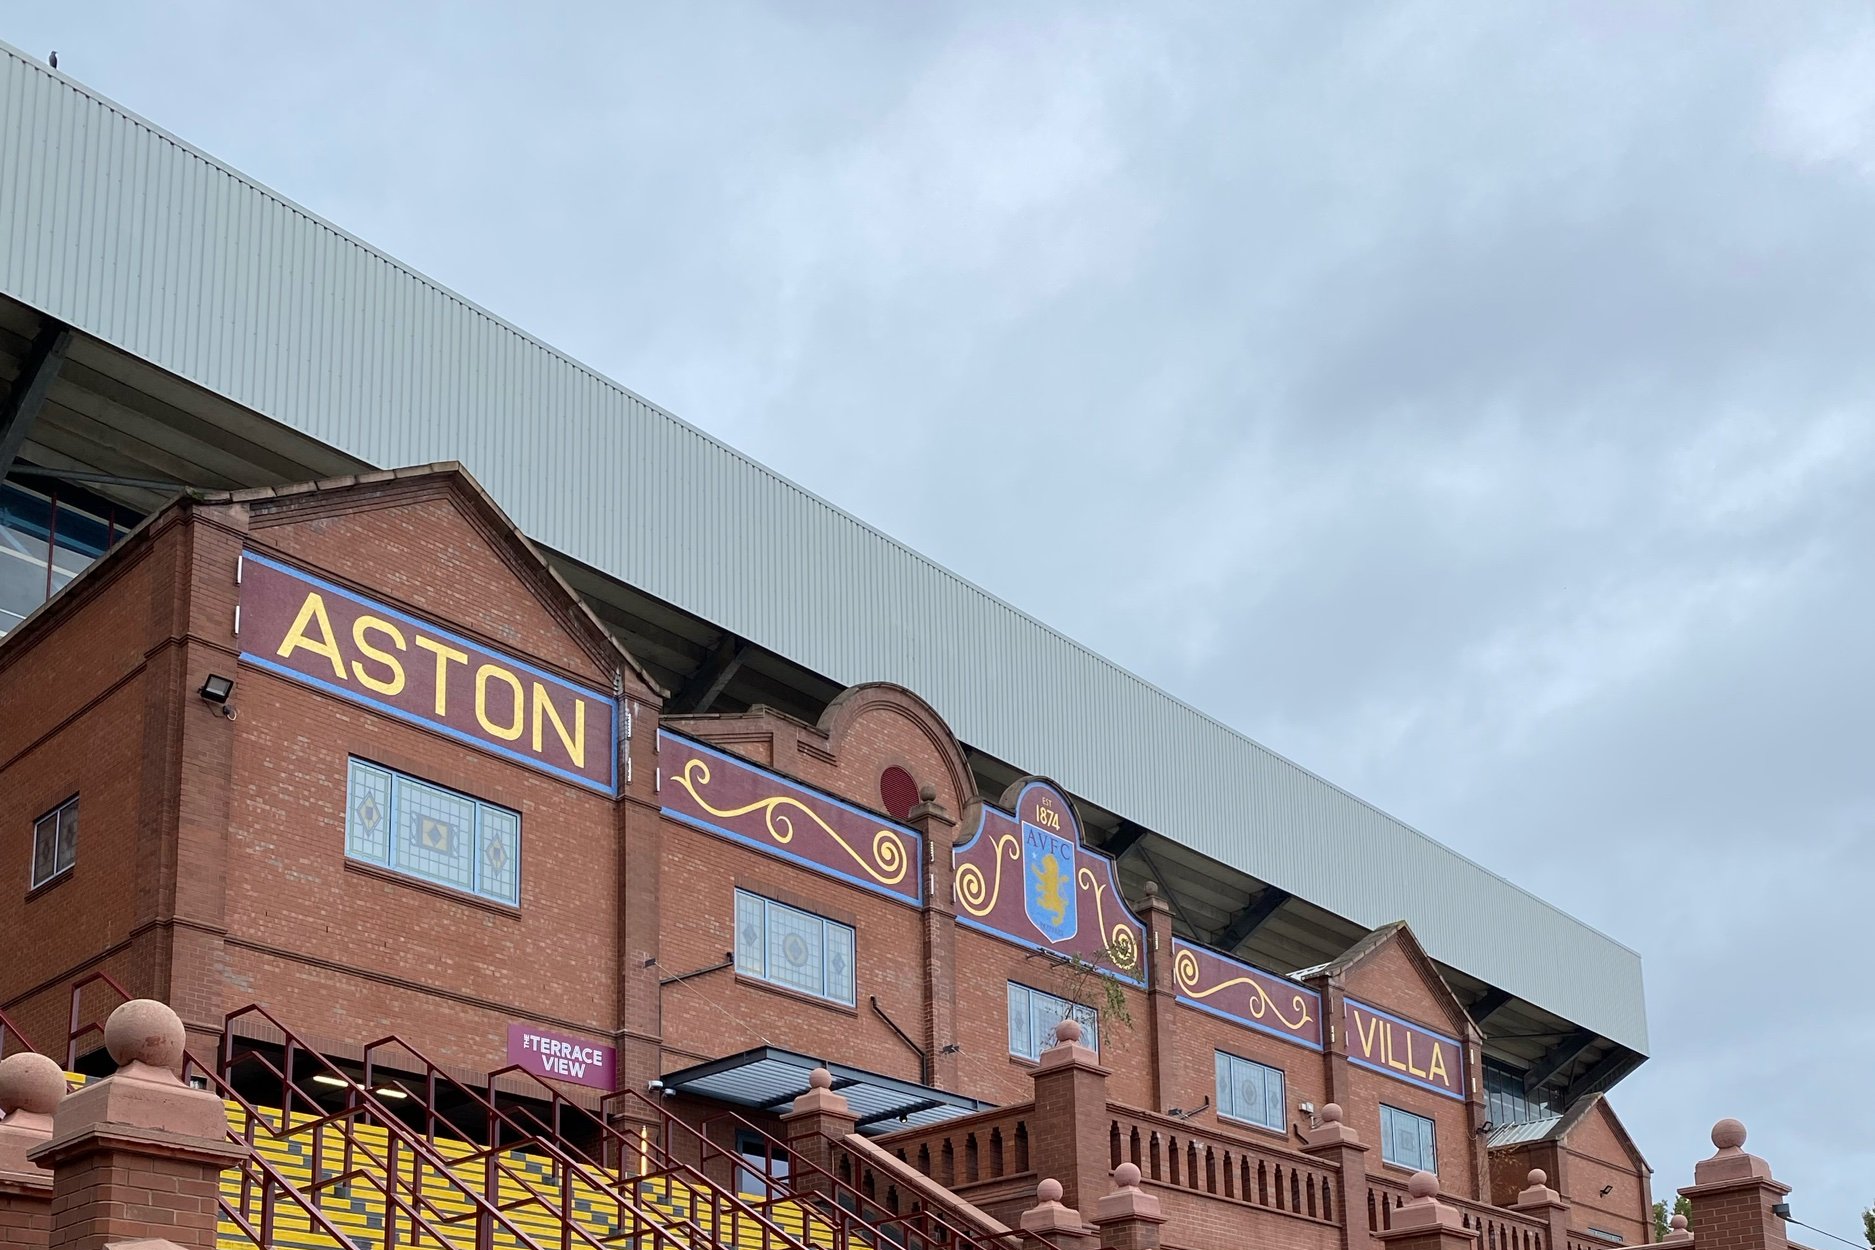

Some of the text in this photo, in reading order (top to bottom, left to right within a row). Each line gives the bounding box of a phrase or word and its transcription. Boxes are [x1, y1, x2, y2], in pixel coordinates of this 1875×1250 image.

[276, 591, 585, 768] ASTON
[1036, 804, 1061, 831] 1874
[1042, 797, 1053, 807] EST
[1027, 829, 1070, 860] AVFC
[530, 1035, 602, 1066] TERRACE
[1353, 1010, 1450, 1086] VILLA
[541, 1055, 585, 1078] VIEW
